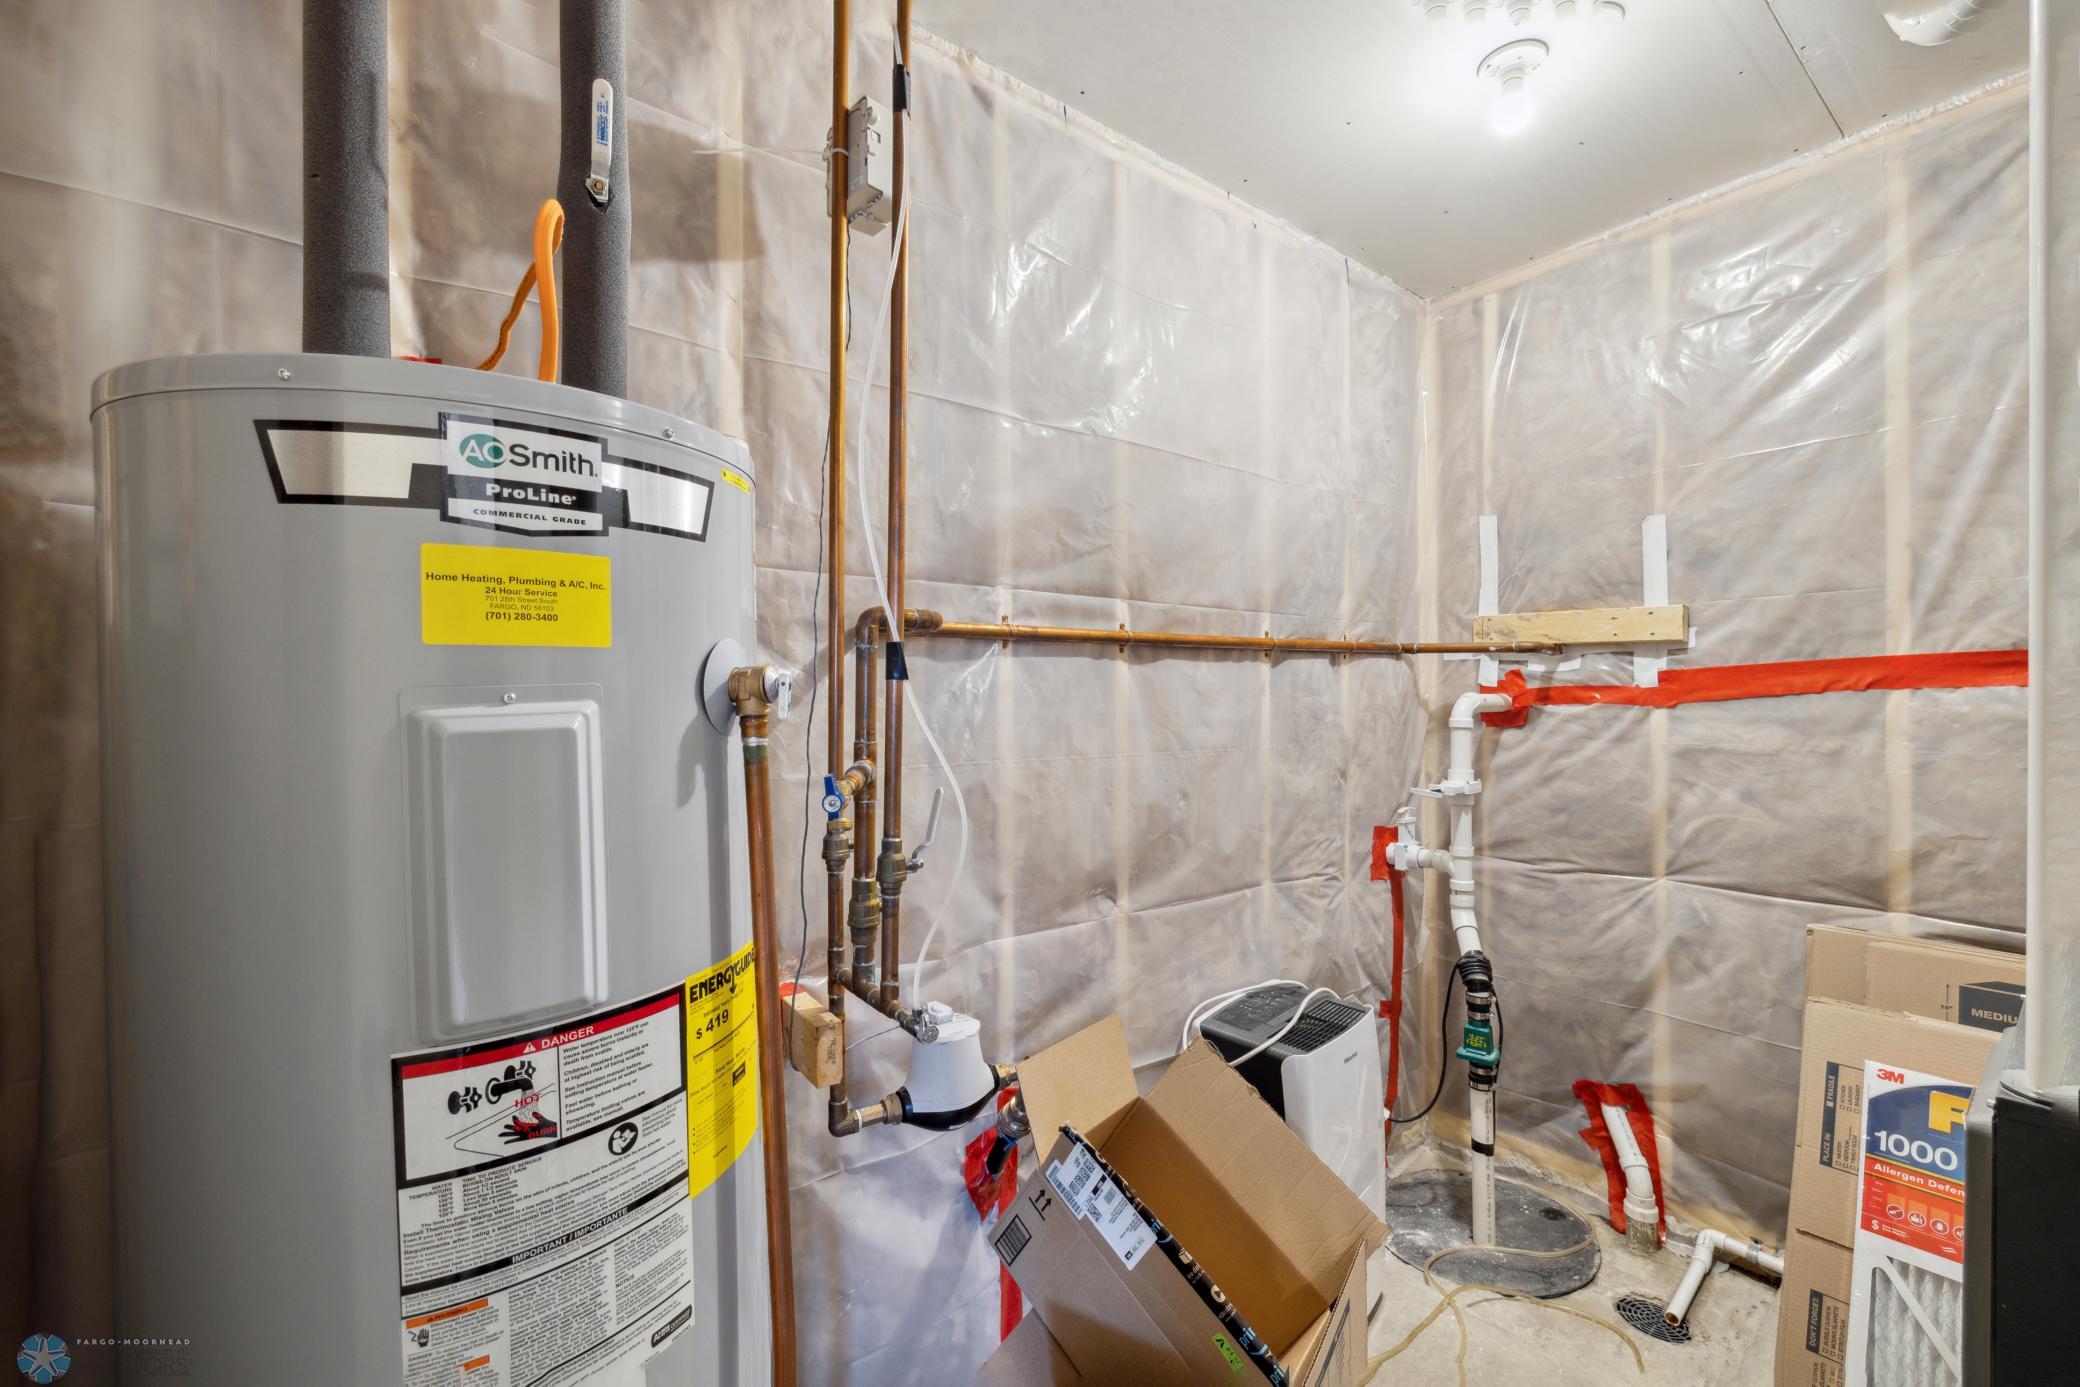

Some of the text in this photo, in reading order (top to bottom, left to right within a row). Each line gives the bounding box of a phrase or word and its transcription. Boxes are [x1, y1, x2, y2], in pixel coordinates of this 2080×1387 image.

[473, 508, 586, 525] COMMERCIAL GRADE
[426, 572, 606, 591] Home Heating, Plumbing & A/C, Inc.
[485, 586, 558, 598] 24 Hour Service
[489, 603, 518, 611] FARGO,
[485, 611, 559, 623] (701) 280-3400
[696, 1009, 728, 1039] $ 419
[1971, 1008, 2017, 1024] MEDIU
[541, 1025, 595, 1049] DANGER
[1876, 1068, 1904, 1085] 3M
[1827, 1074, 1835, 1100] FRAGILE
[514, 1093, 541, 1108] HOT
[1874, 1129, 1958, 1172] 1000
[1872, 1162, 1965, 1198] Allergen Defen
[512, 1236, 568, 1264] IMPORTANT
[569, 1232, 574, 1241] /
[574, 1206, 628, 1240] IMPORTANTE
[616, 1273, 635, 1288] NOTICE
[1809, 1325, 1817, 1347] DON'T
